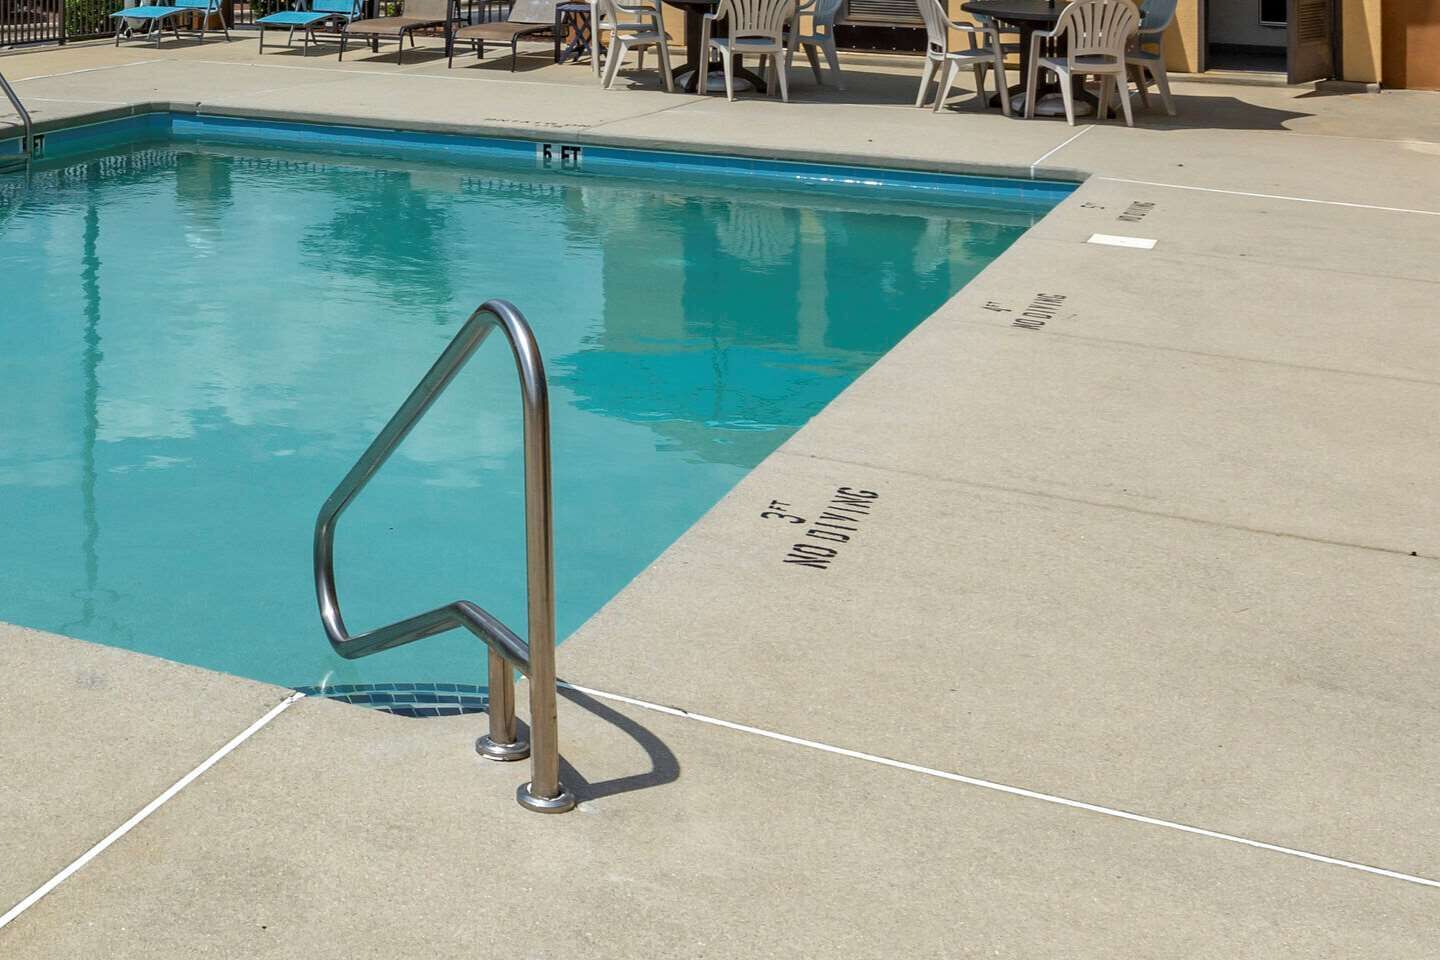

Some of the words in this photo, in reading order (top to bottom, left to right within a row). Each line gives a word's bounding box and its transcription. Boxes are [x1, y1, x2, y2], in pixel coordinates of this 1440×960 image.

[561, 145, 580, 161] FT
[1022, 293, 1066, 319] DIVING
[1010, 318, 1045, 331] NO
[806, 486, 879, 544] DIVING
[783, 543, 838, 570] NO
